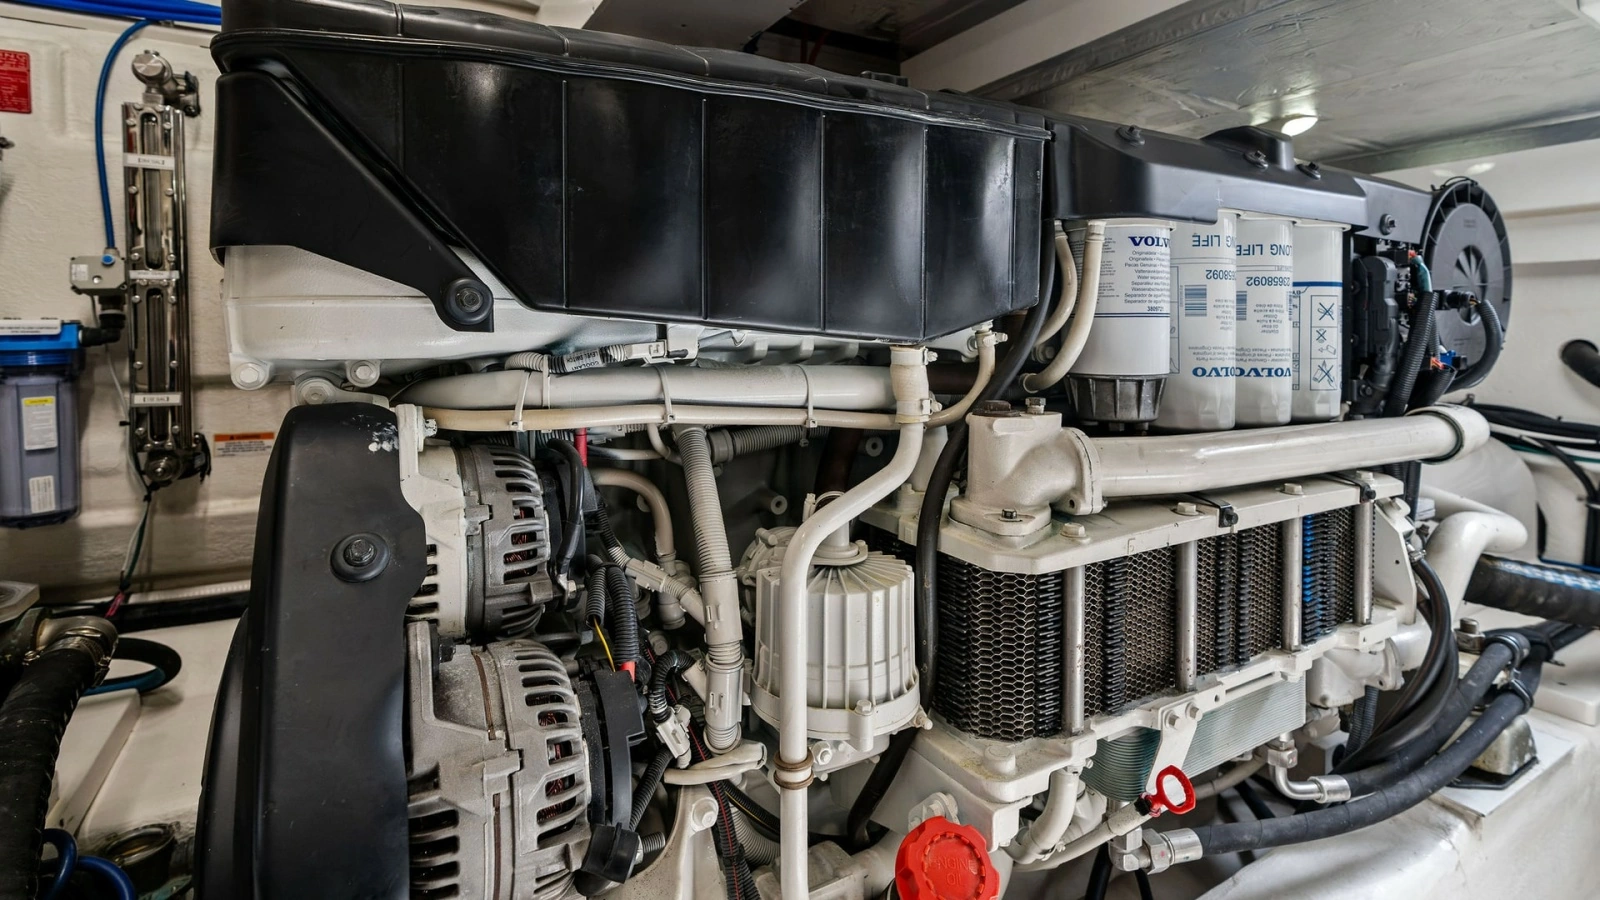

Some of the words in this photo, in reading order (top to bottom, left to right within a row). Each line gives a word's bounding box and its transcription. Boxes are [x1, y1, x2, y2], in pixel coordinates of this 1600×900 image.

[1192, 235, 1220, 246] LIFE
[1270, 244, 1292, 256] ONG
[1246, 276, 1290, 286] 23658092
